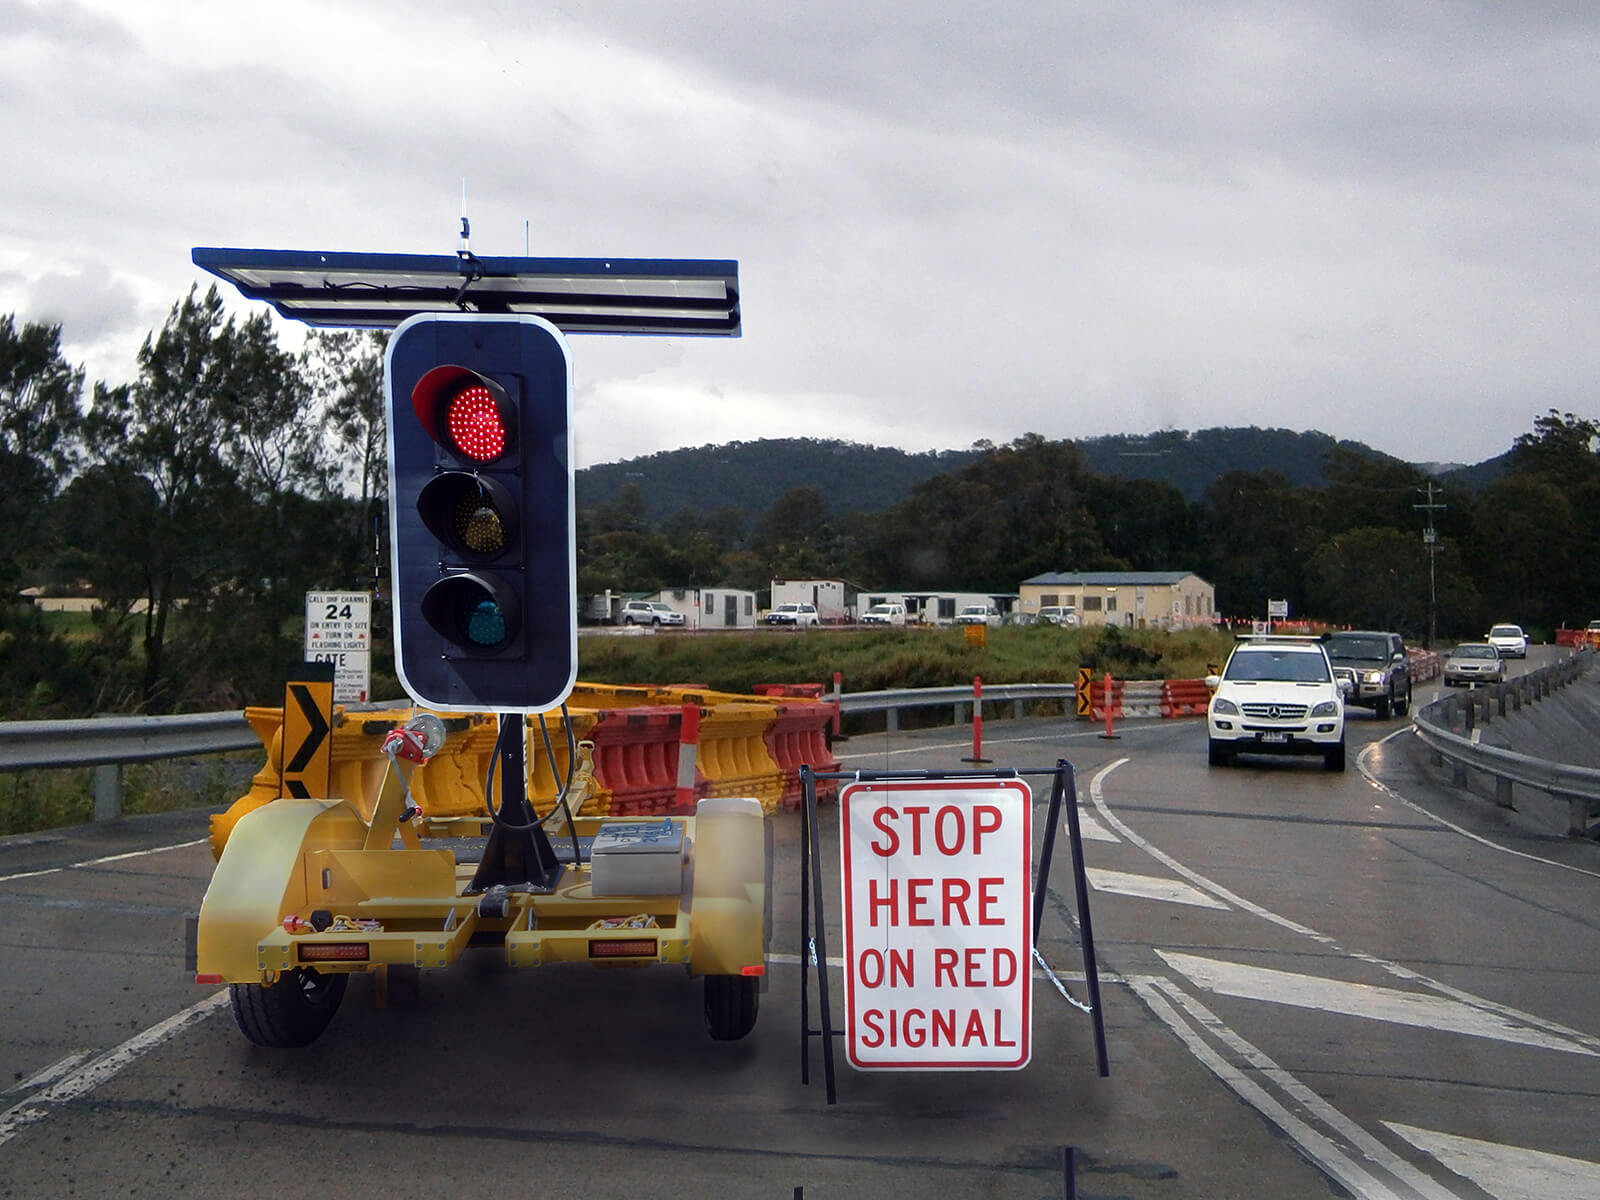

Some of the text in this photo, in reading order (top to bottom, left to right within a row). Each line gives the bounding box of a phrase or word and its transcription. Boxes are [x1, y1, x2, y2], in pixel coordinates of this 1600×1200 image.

[325, 604, 352, 620] 24
[315, 653, 346, 667] GATE
[870, 805, 1003, 857] STOP
[869, 877, 1005, 927] HERE
[860, 948, 1017, 989] ON RED
[861, 1009, 1016, 1048] SIGNAL
